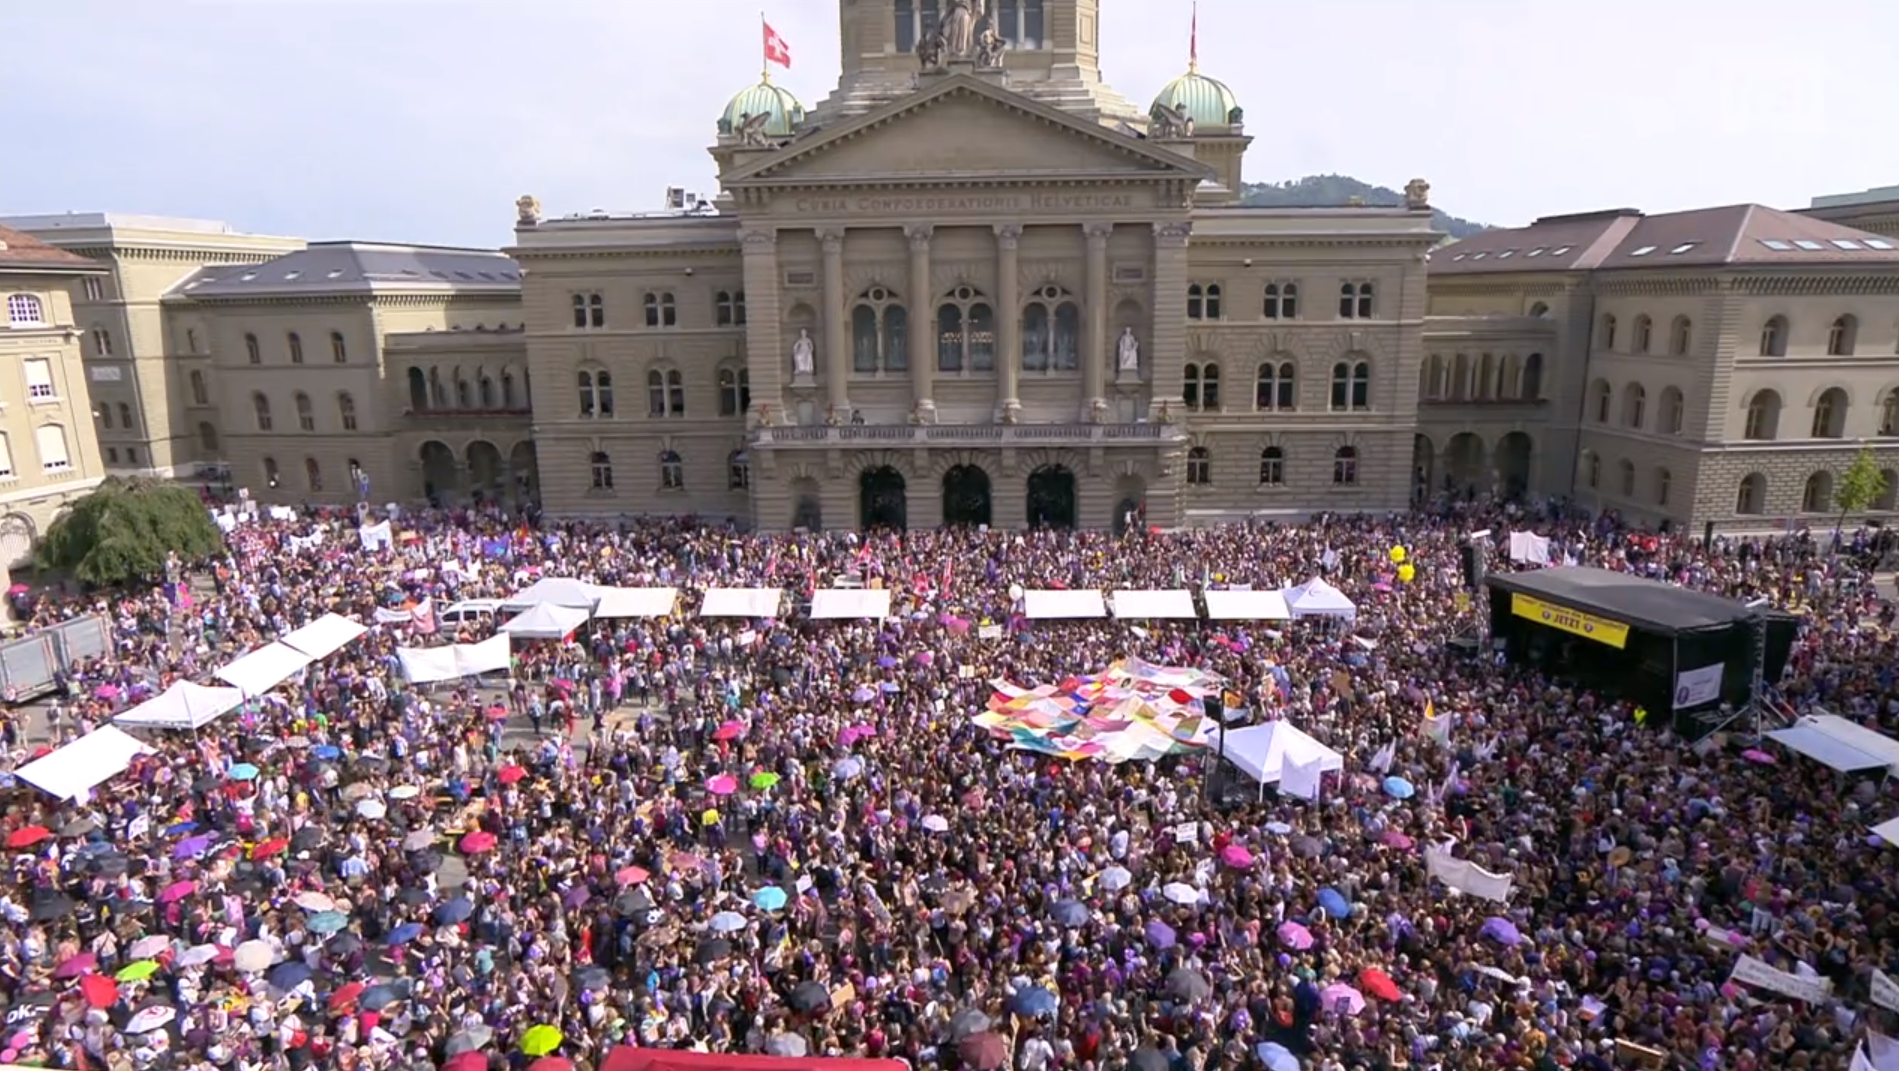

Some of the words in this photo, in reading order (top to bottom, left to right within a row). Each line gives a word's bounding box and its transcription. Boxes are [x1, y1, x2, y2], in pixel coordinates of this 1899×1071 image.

[796, 198, 847, 212] CURIA
[1030, 192, 1132, 209] HELVETICAE
[1554, 613, 1580, 629] JETZT
